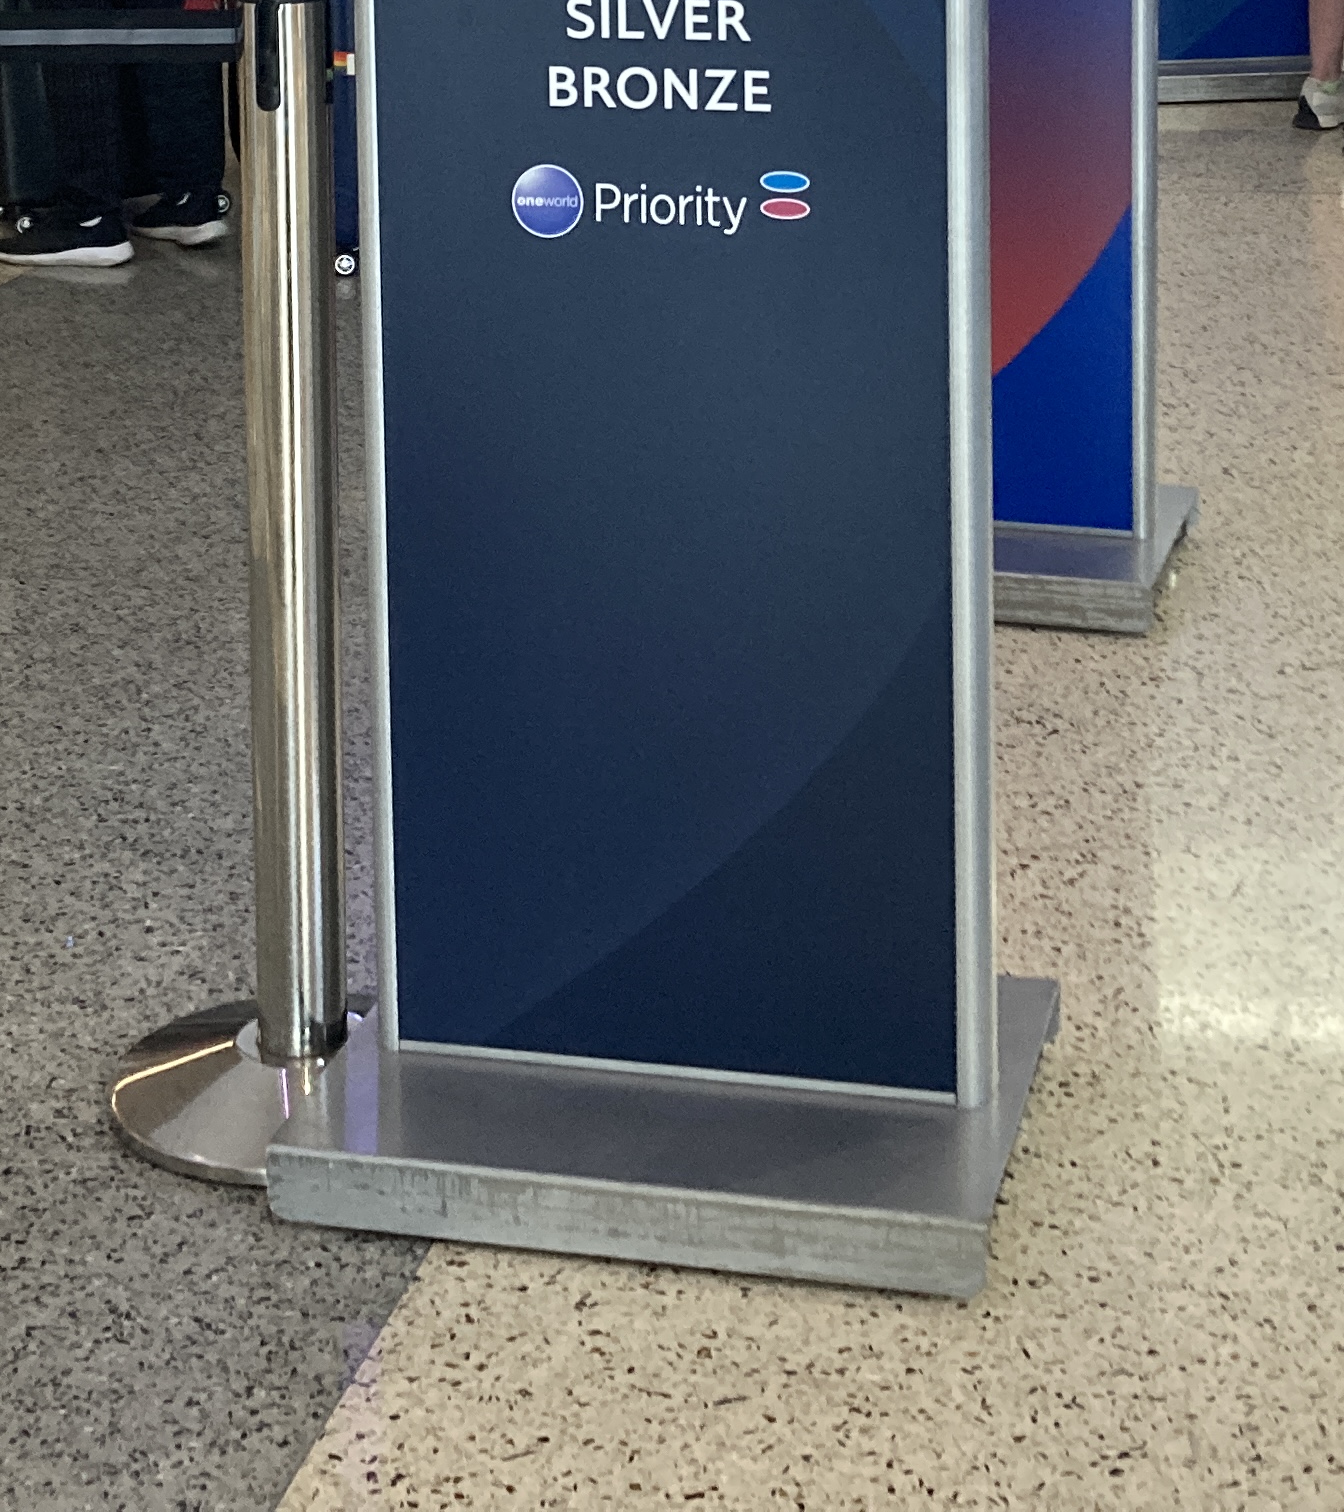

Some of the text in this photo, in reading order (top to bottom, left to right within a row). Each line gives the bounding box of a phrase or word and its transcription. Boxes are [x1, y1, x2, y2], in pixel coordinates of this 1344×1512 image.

[548, 65, 773, 113] BRONZE
[516, 182, 748, 236] oneworld Priority
